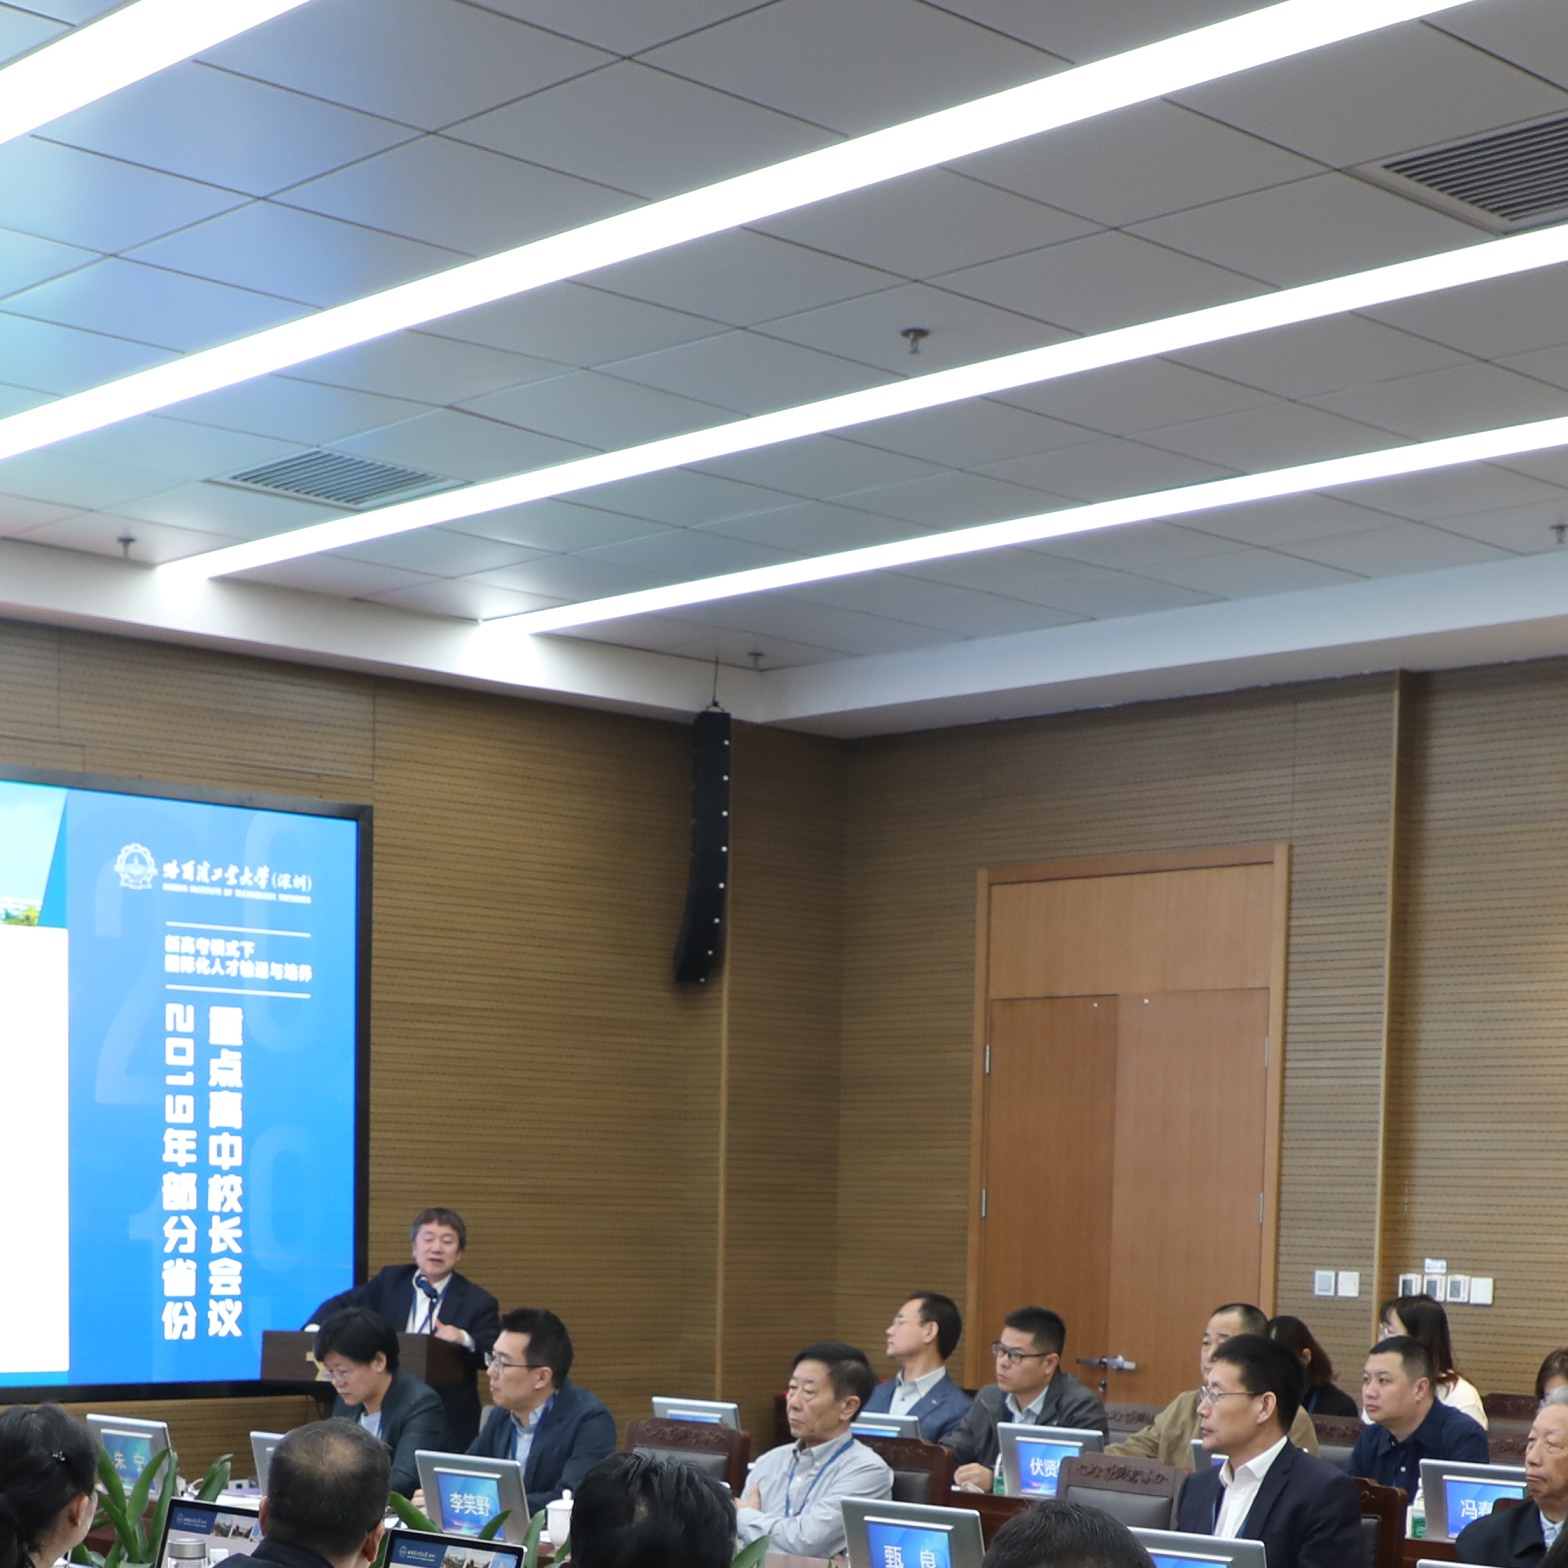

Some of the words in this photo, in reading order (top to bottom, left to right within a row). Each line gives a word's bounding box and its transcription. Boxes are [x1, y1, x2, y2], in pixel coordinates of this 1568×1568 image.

[1029, 1457, 1060, 1478] 伏贤
[449, 1491, 491, 1517] 李笑野
